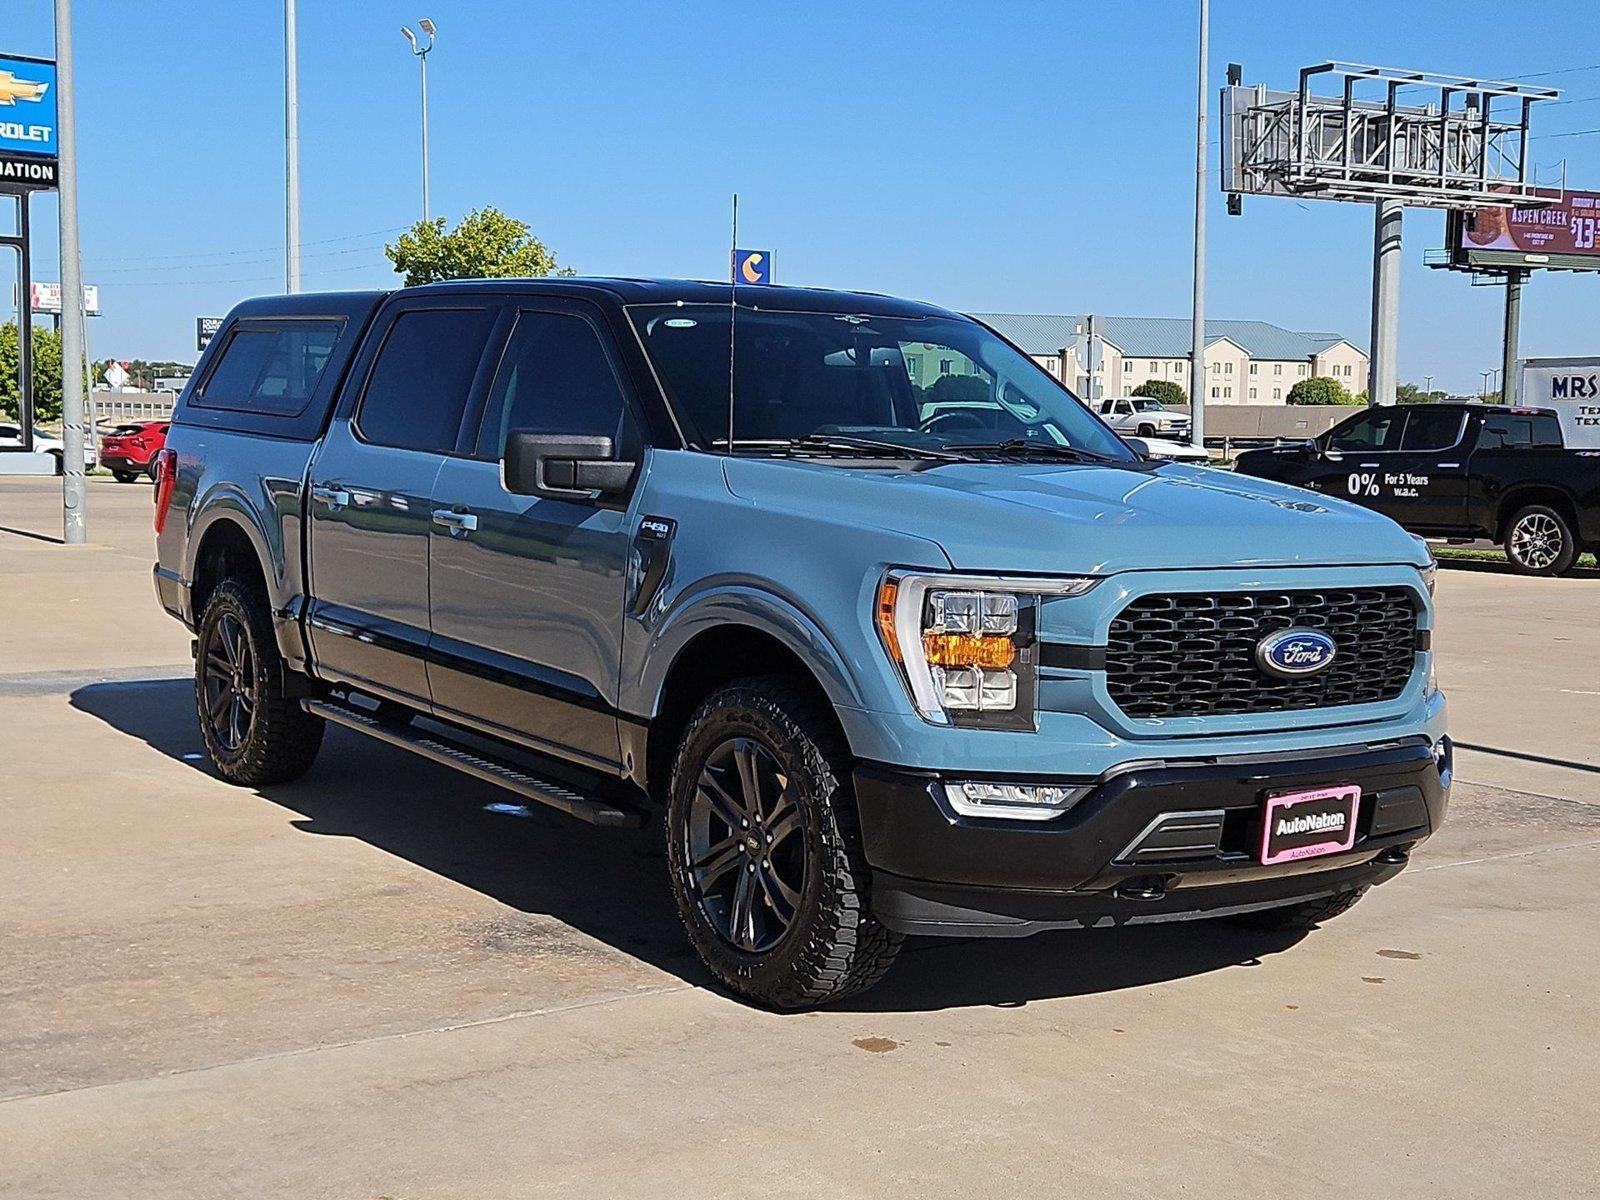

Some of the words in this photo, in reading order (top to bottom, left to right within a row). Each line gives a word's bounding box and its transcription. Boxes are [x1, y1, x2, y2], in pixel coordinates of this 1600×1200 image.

[0, 161, 53, 180] ATION
[1512, 208, 1539, 224] ASPEN
[1541, 210, 1568, 226] CREEK
[1551, 374, 1598, 398] MRS
[1348, 473, 1380, 496] 0%
[1384, 473, 1398, 485] For
[1399, 473, 1405, 485] 5
[1406, 473, 1429, 486] Years
[1283, 641, 1324, 664] Ford
[1276, 812, 1345, 836] AutoNation
[1291, 847, 1326, 859] AutoNation
